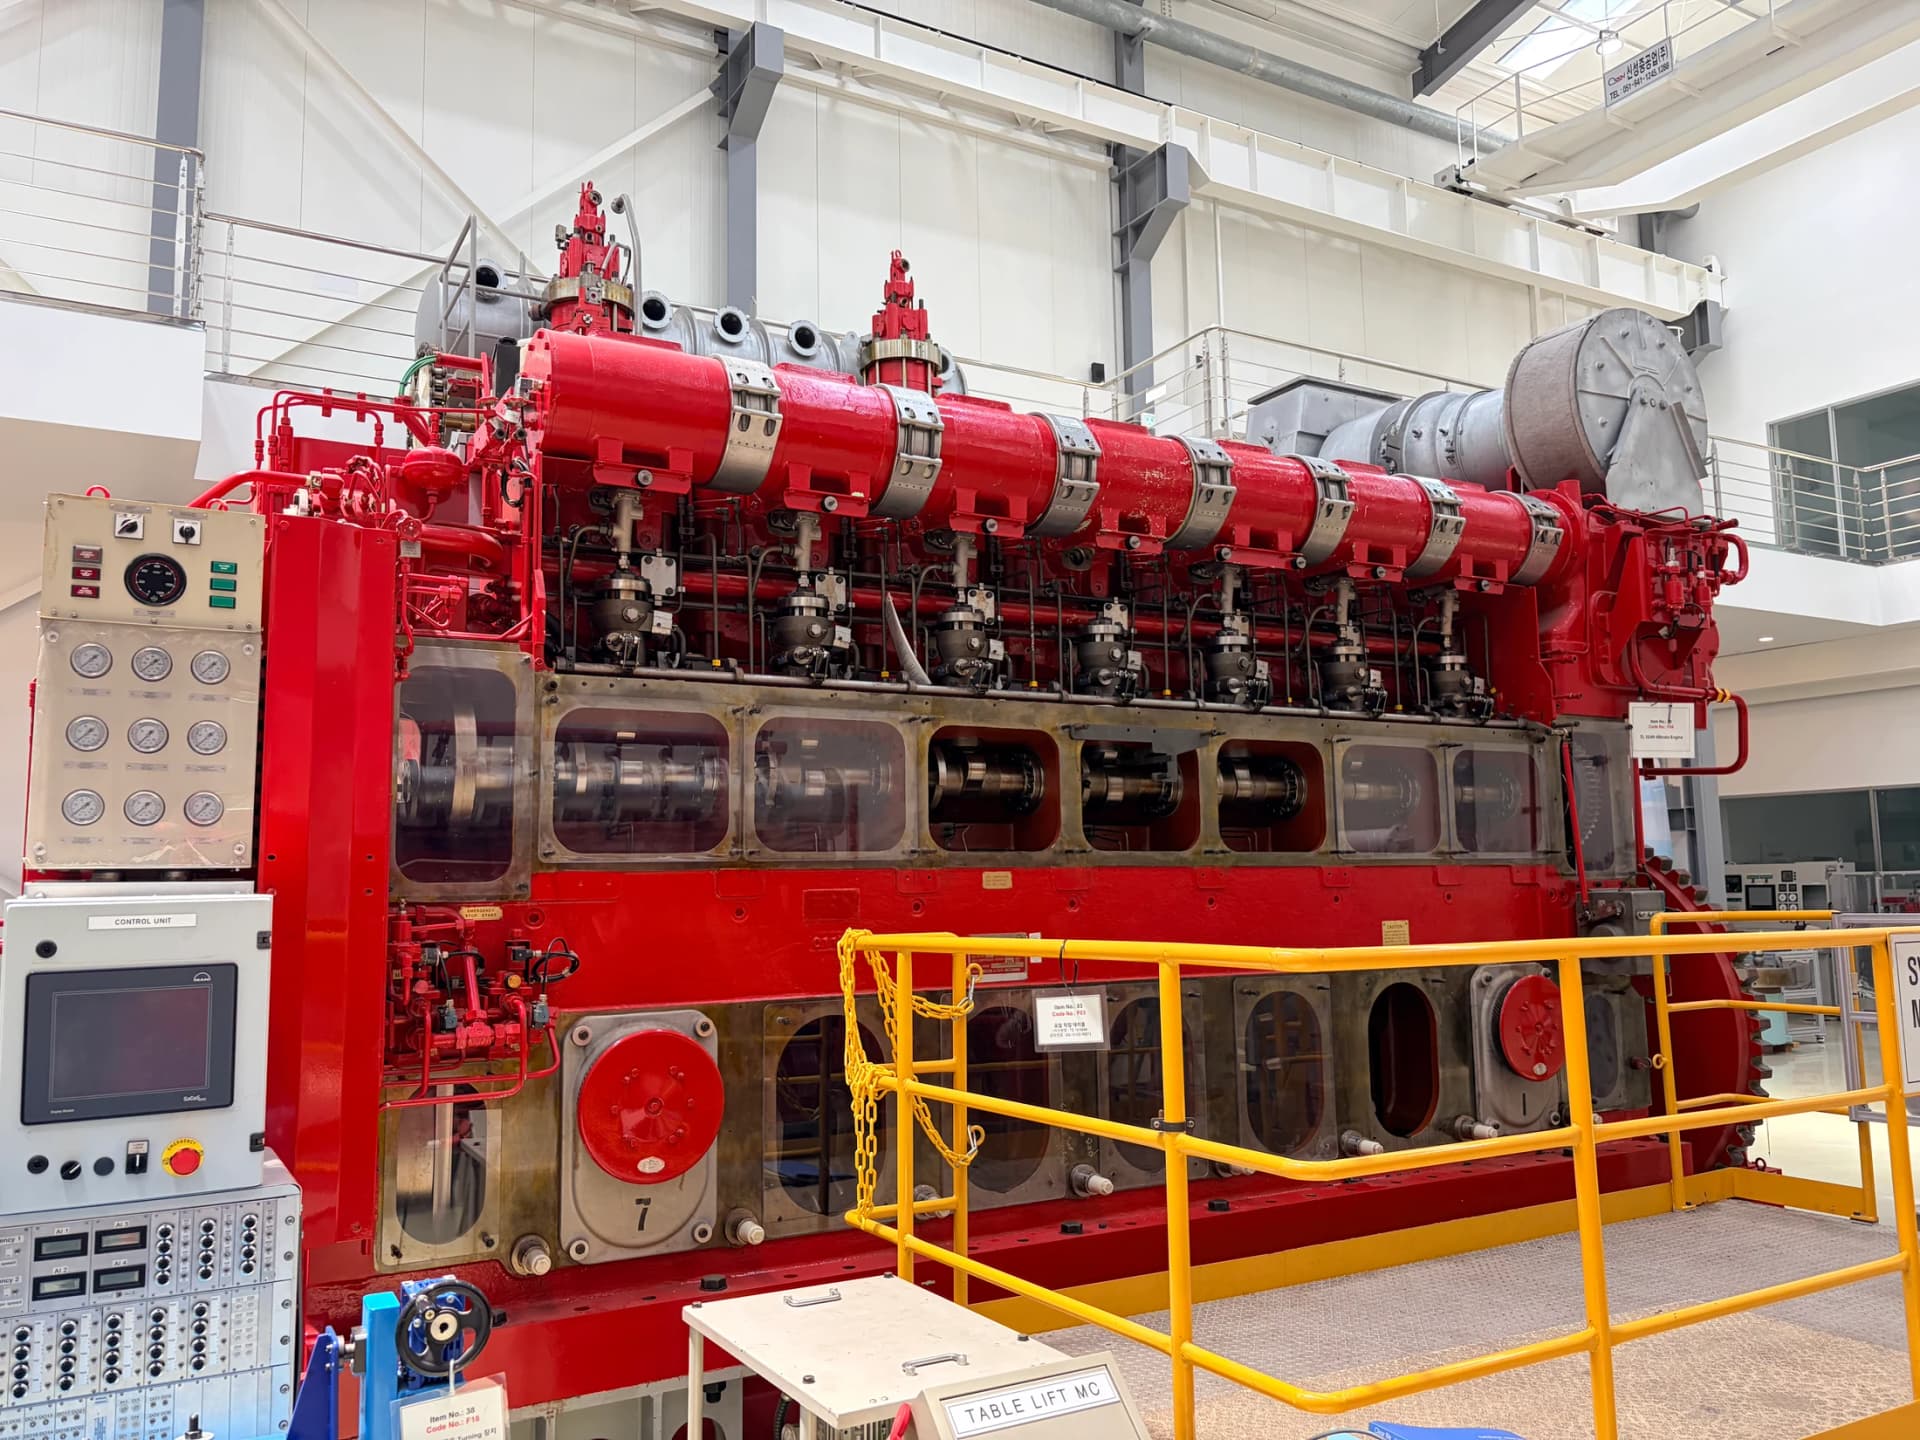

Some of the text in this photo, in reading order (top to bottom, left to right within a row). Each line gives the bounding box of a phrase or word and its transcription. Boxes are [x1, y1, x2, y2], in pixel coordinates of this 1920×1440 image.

[1609, 90, 1620, 100] TEL
[114, 918, 151, 926] CONTROL
[633, 1197, 652, 1232] 7
[965, 1381, 1101, 1424] TABLE LIFT MC
[430, 1414, 447, 1423] Item
[426, 1424, 446, 1434] Code
